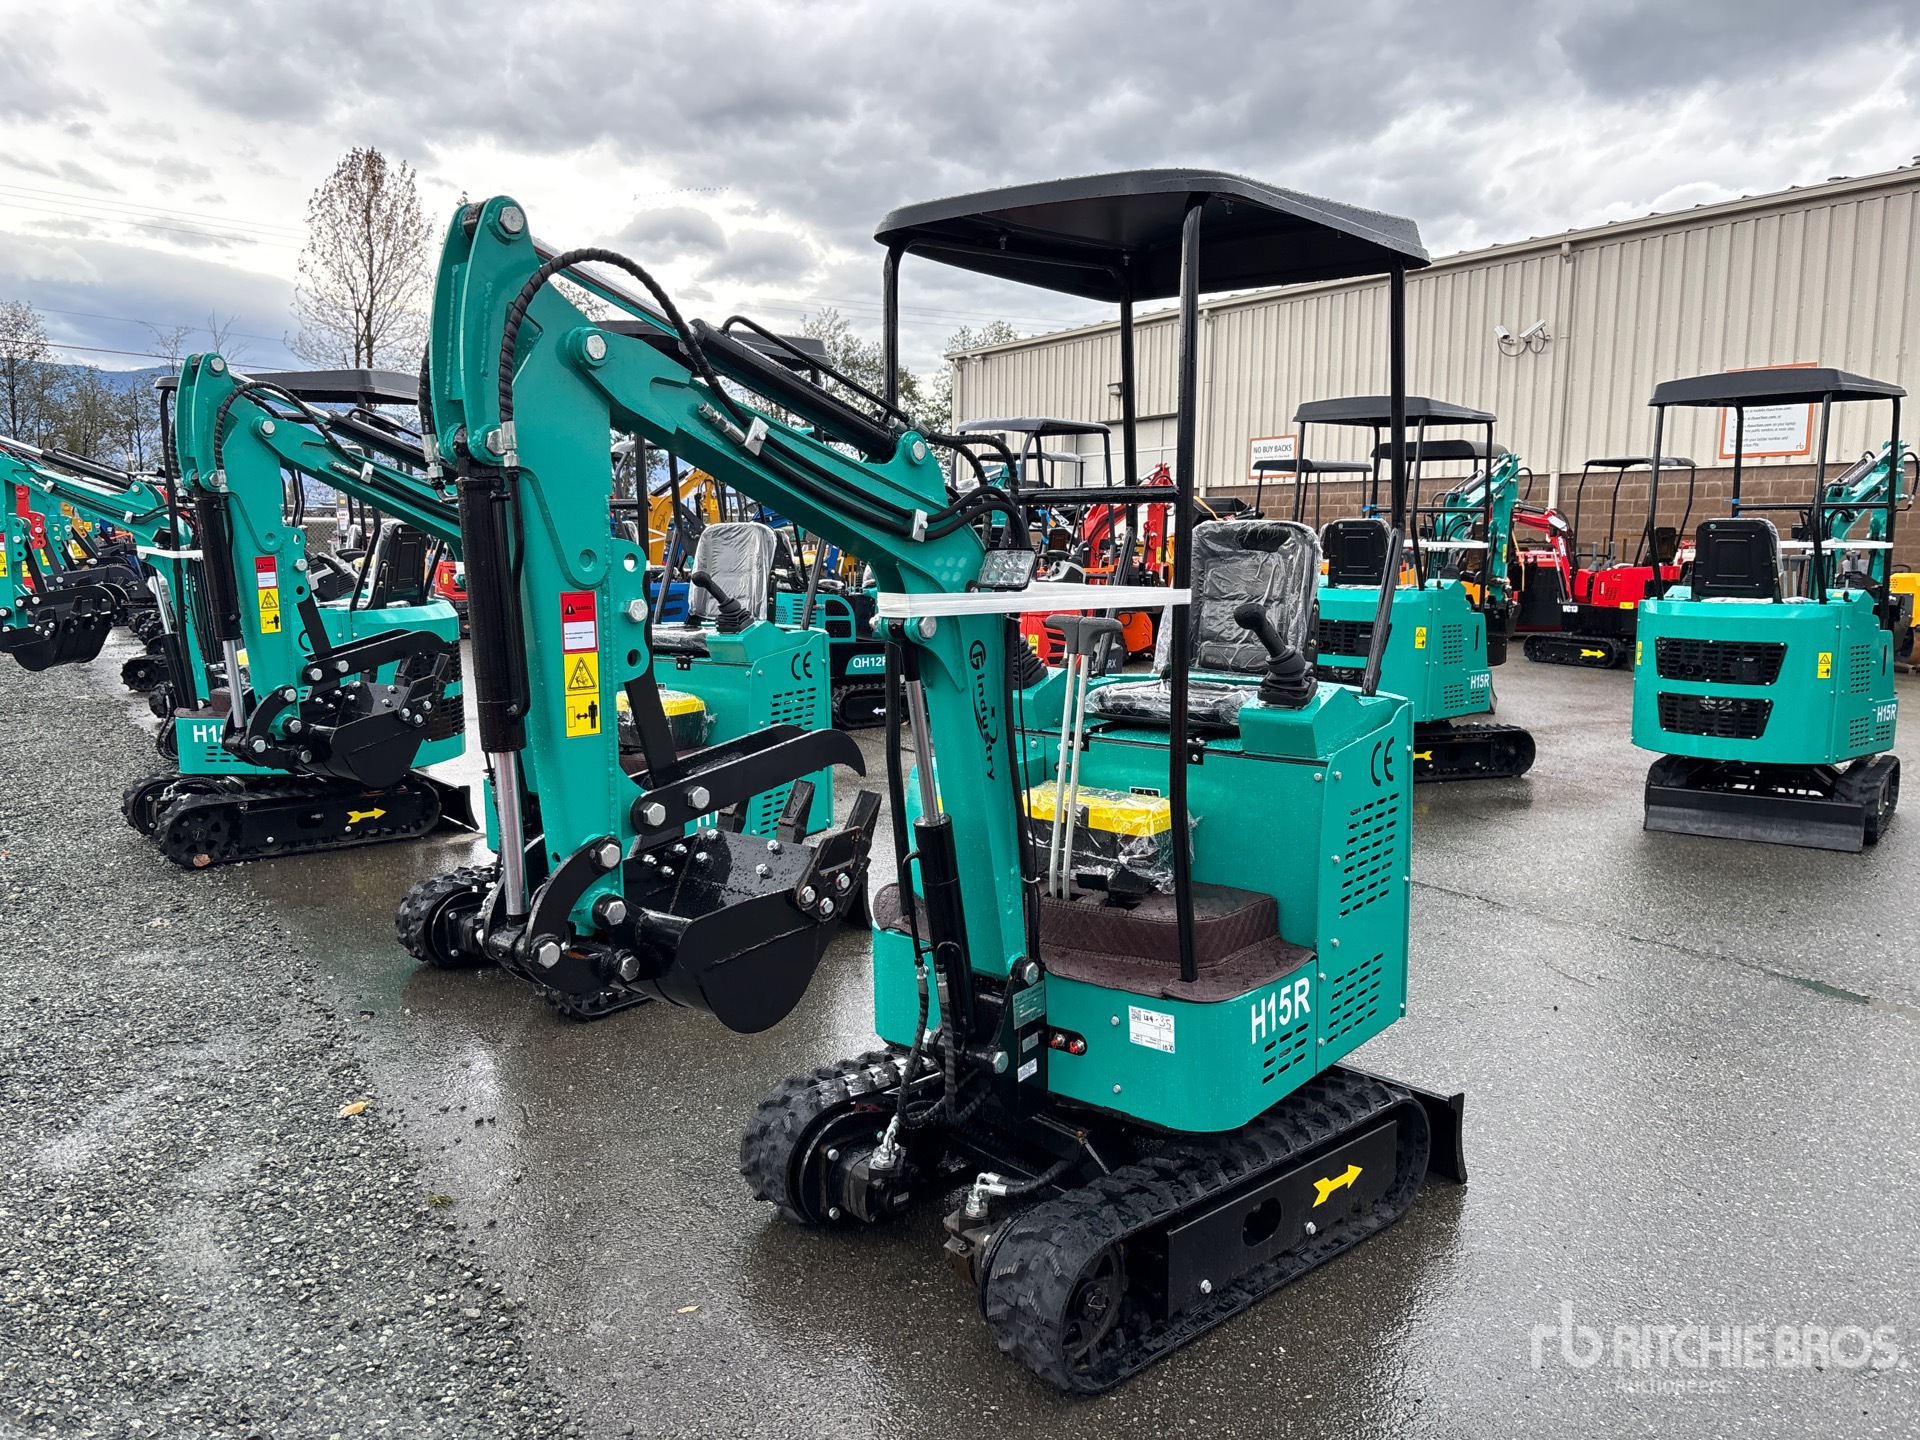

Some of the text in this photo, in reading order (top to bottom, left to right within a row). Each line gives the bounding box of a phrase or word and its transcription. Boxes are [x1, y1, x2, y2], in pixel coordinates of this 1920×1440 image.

[1263, 445, 1273, 453] BUY
[1274, 443, 1292, 452] BACKS
[1470, 673, 1490, 689] H15R
[1876, 703, 1897, 723] H15R
[193, 724, 224, 745] H1
[1251, 976, 1311, 1045] H15R
